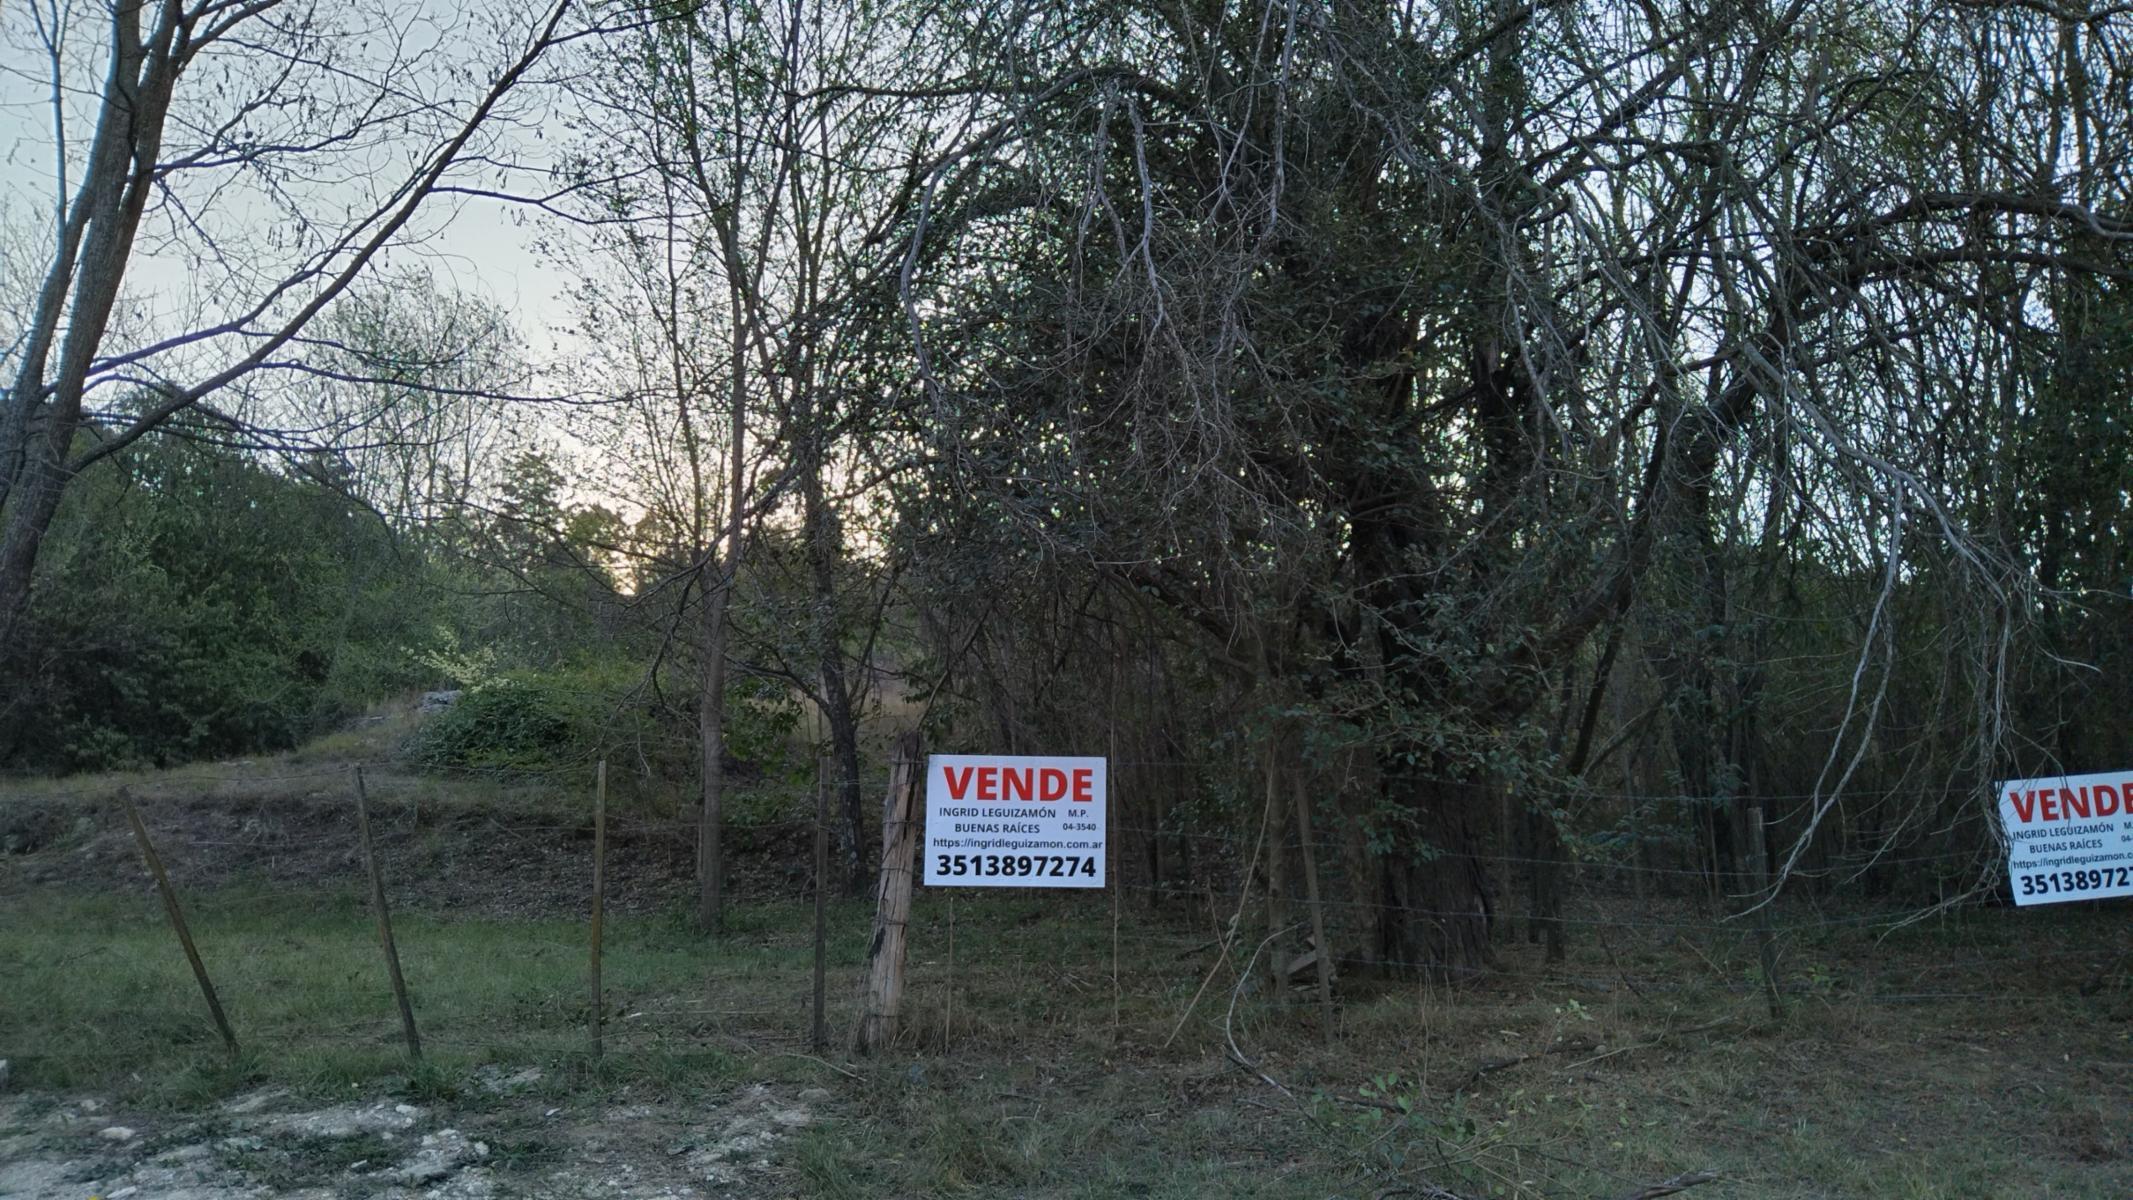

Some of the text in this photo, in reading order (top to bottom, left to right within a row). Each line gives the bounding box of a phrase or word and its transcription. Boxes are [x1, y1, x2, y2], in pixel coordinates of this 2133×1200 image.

[943, 766, 1093, 802] VENDE
[2009, 782, 2133, 823] VENDE
[939, 807, 1056, 818] INGRID LEGUIZAMÓN
[1068, 809, 1089, 818] M.P.
[955, 822, 1040, 834] BUENAS RAÍCES
[1063, 823, 1096, 831] 04-3540
[2013, 822, 2114, 840] INGRID LEGUIZAMÓN
[933, 837, 1103, 850] https://ingridleguizamon.com.ar
[2030, 839, 2103, 854] BUENAS RAÍCES
[937, 855, 1096, 877] 3513897274
